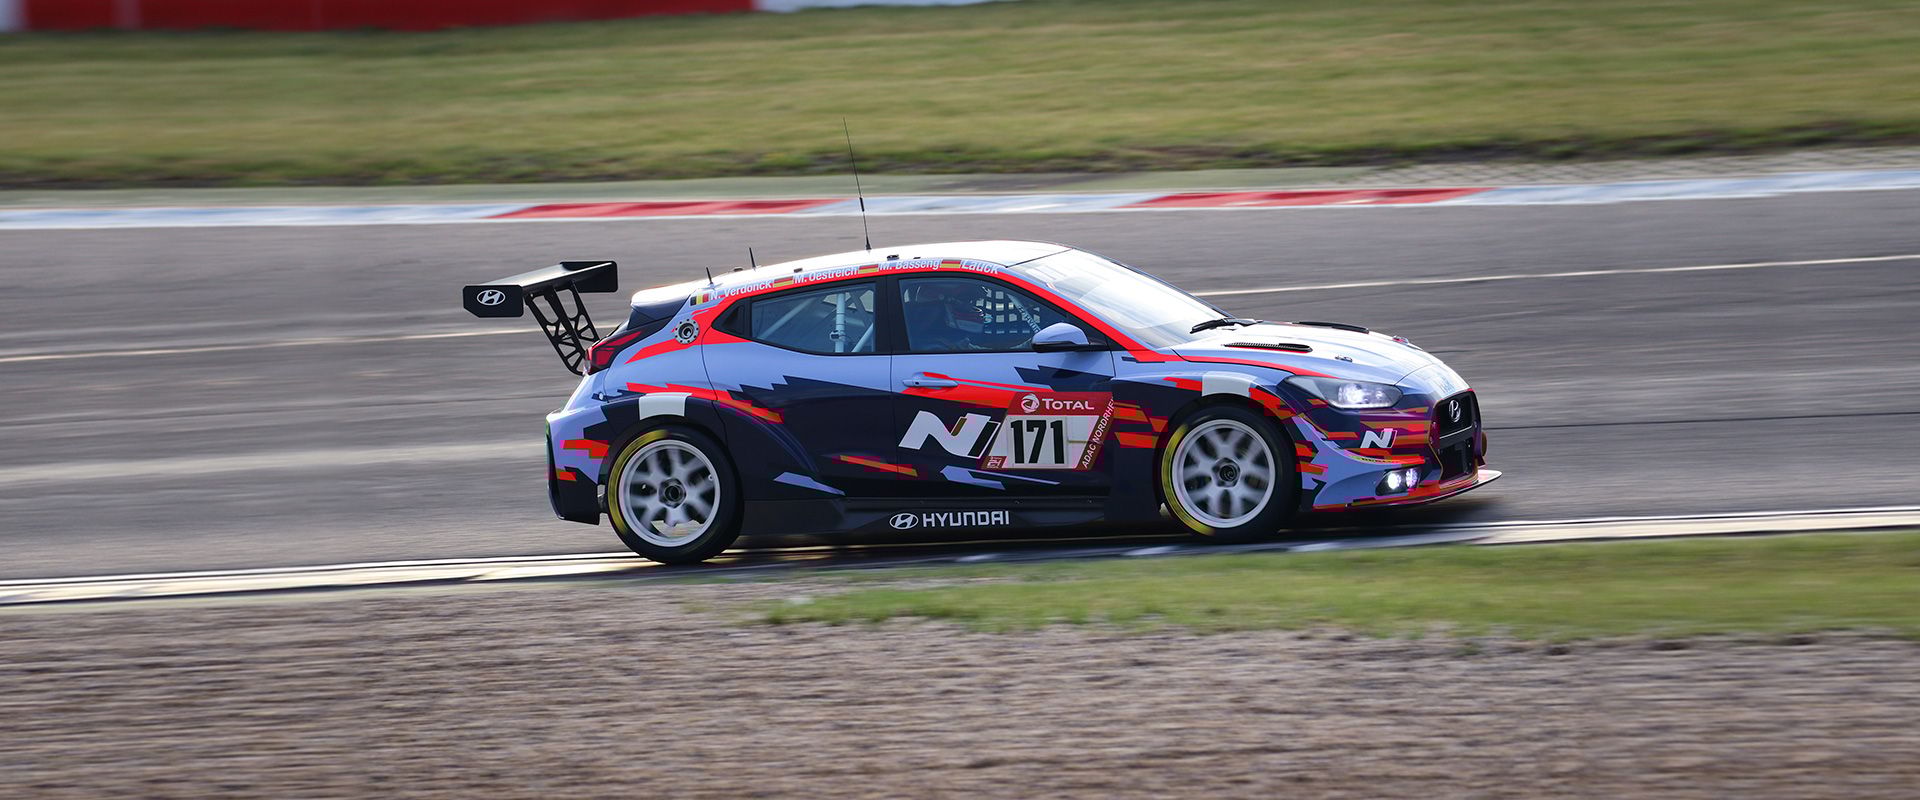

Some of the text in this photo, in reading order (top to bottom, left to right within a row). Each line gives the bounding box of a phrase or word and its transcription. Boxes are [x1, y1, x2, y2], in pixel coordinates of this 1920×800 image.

[710, 258, 999, 301] N. Verdonck M. Oestreich M. Basseng Lauck
[1041, 398, 1095, 410] TOTAL
[1010, 419, 1065, 464] 171
[1081, 398, 1115, 468] ADAC NORDRHE
[922, 510, 1010, 528] HYUNDAI
